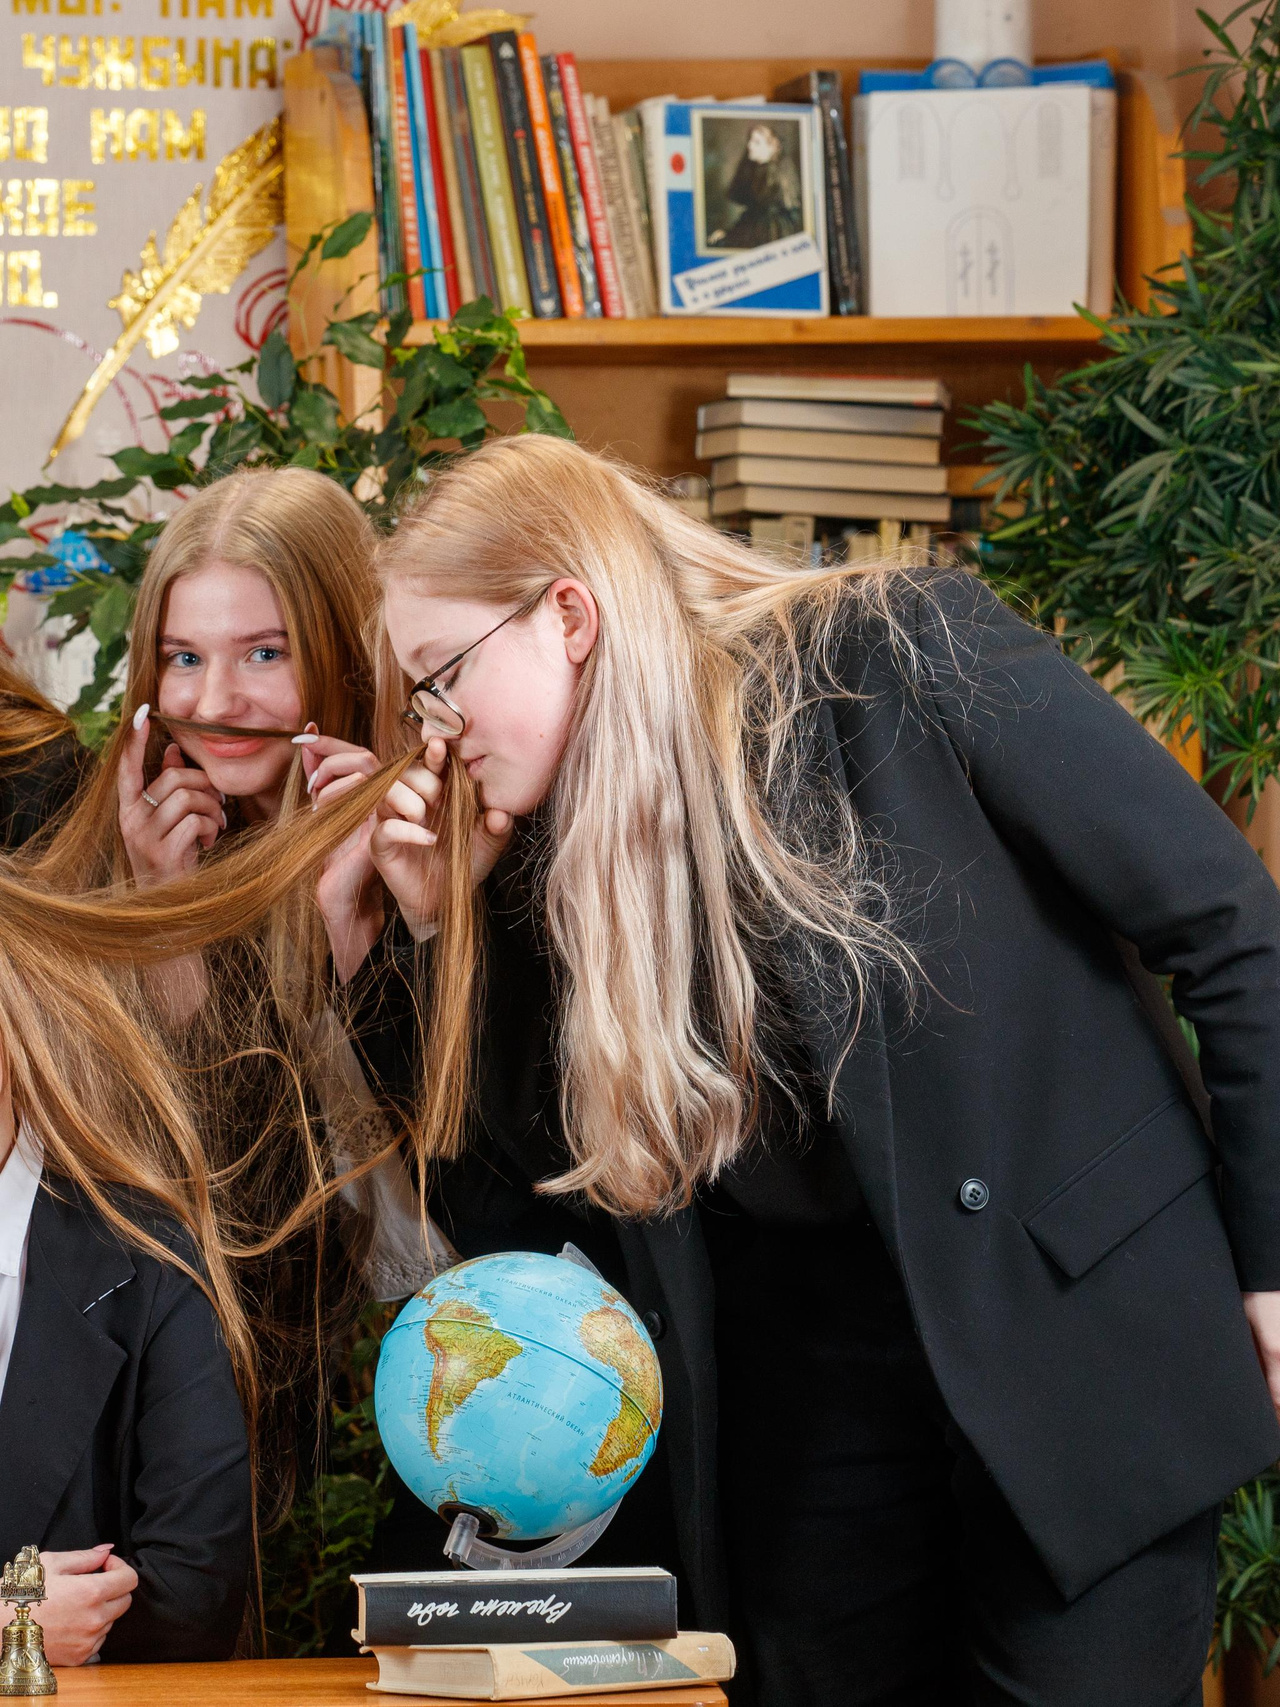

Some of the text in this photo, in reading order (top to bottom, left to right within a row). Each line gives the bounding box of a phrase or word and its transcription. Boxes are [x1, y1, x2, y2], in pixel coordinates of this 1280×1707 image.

[90, 107, 207, 164] НАМ
[496, 1277, 577, 1308] АТЛАНТИЧЕСКИЙ ОКЕАН
[507, 1391, 585, 1437] АТЛАНТИЧЕСКИЙ ОКЕАН
[407, 1594, 572, 1626] Времена года
